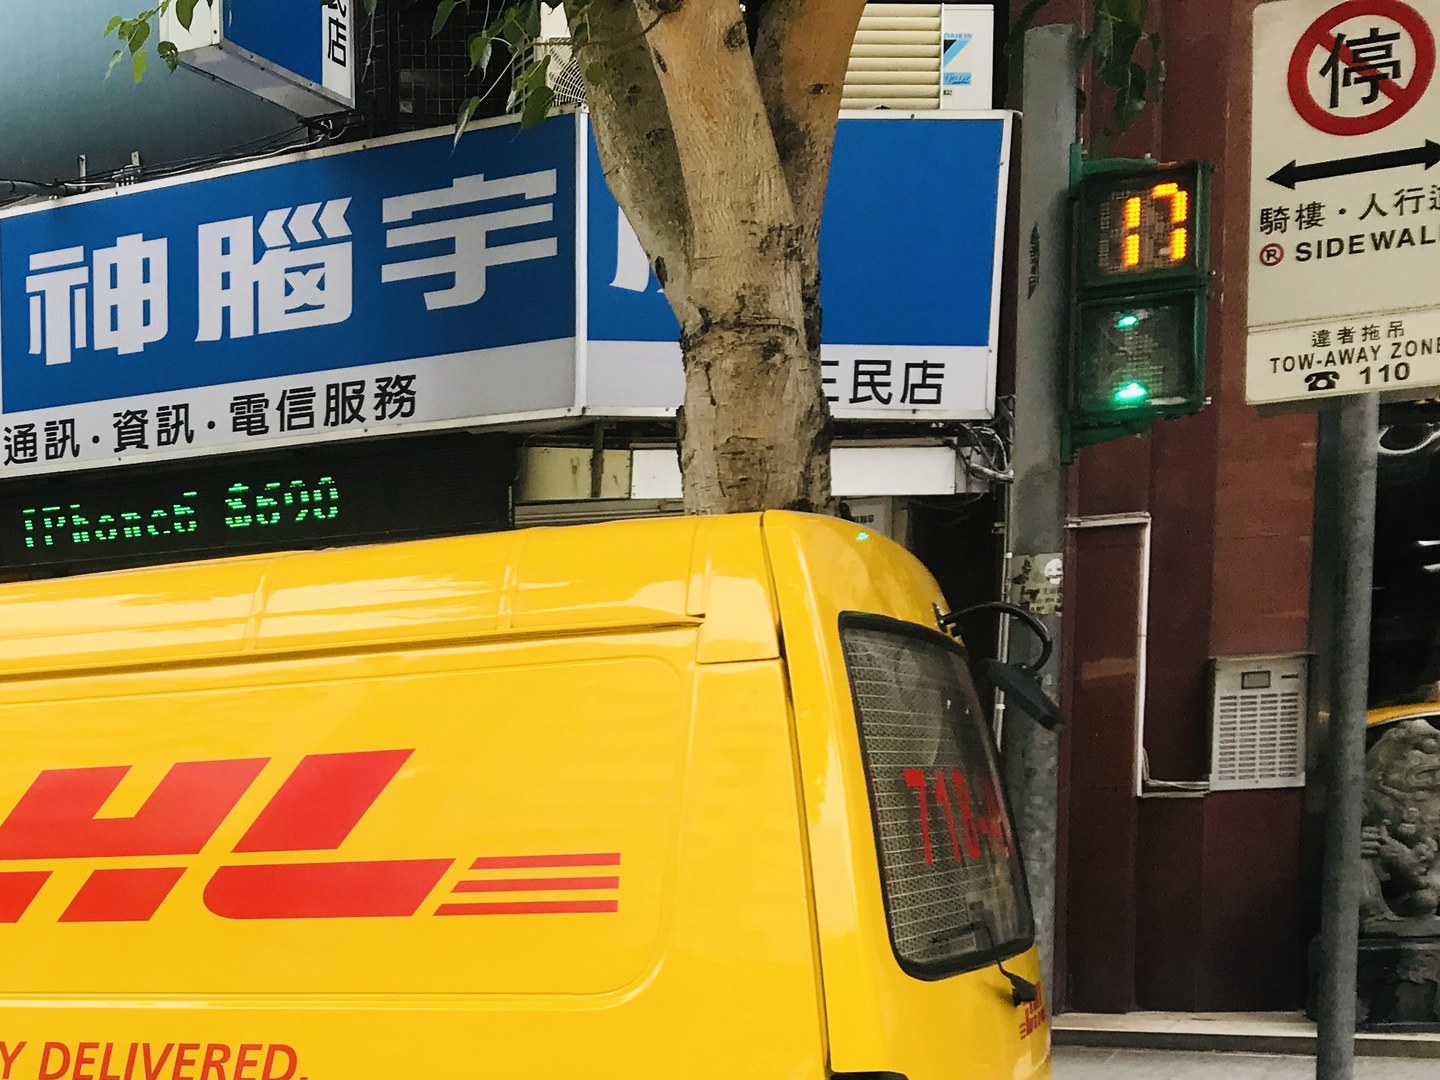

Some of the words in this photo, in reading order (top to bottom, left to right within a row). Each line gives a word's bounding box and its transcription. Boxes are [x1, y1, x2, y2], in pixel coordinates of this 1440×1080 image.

[1320, 27, 1402, 109] 停
[1122, 182, 1189, 267] 17
[1295, 224, 1440, 262] SIDEWAL
[25, 168, 559, 366] 神腦宇
[1312, 320, 1405, 348] 違者拖吊
[1269, 345, 1381, 374] TOW-AWAY
[1360, 362, 1411, 385] 110
